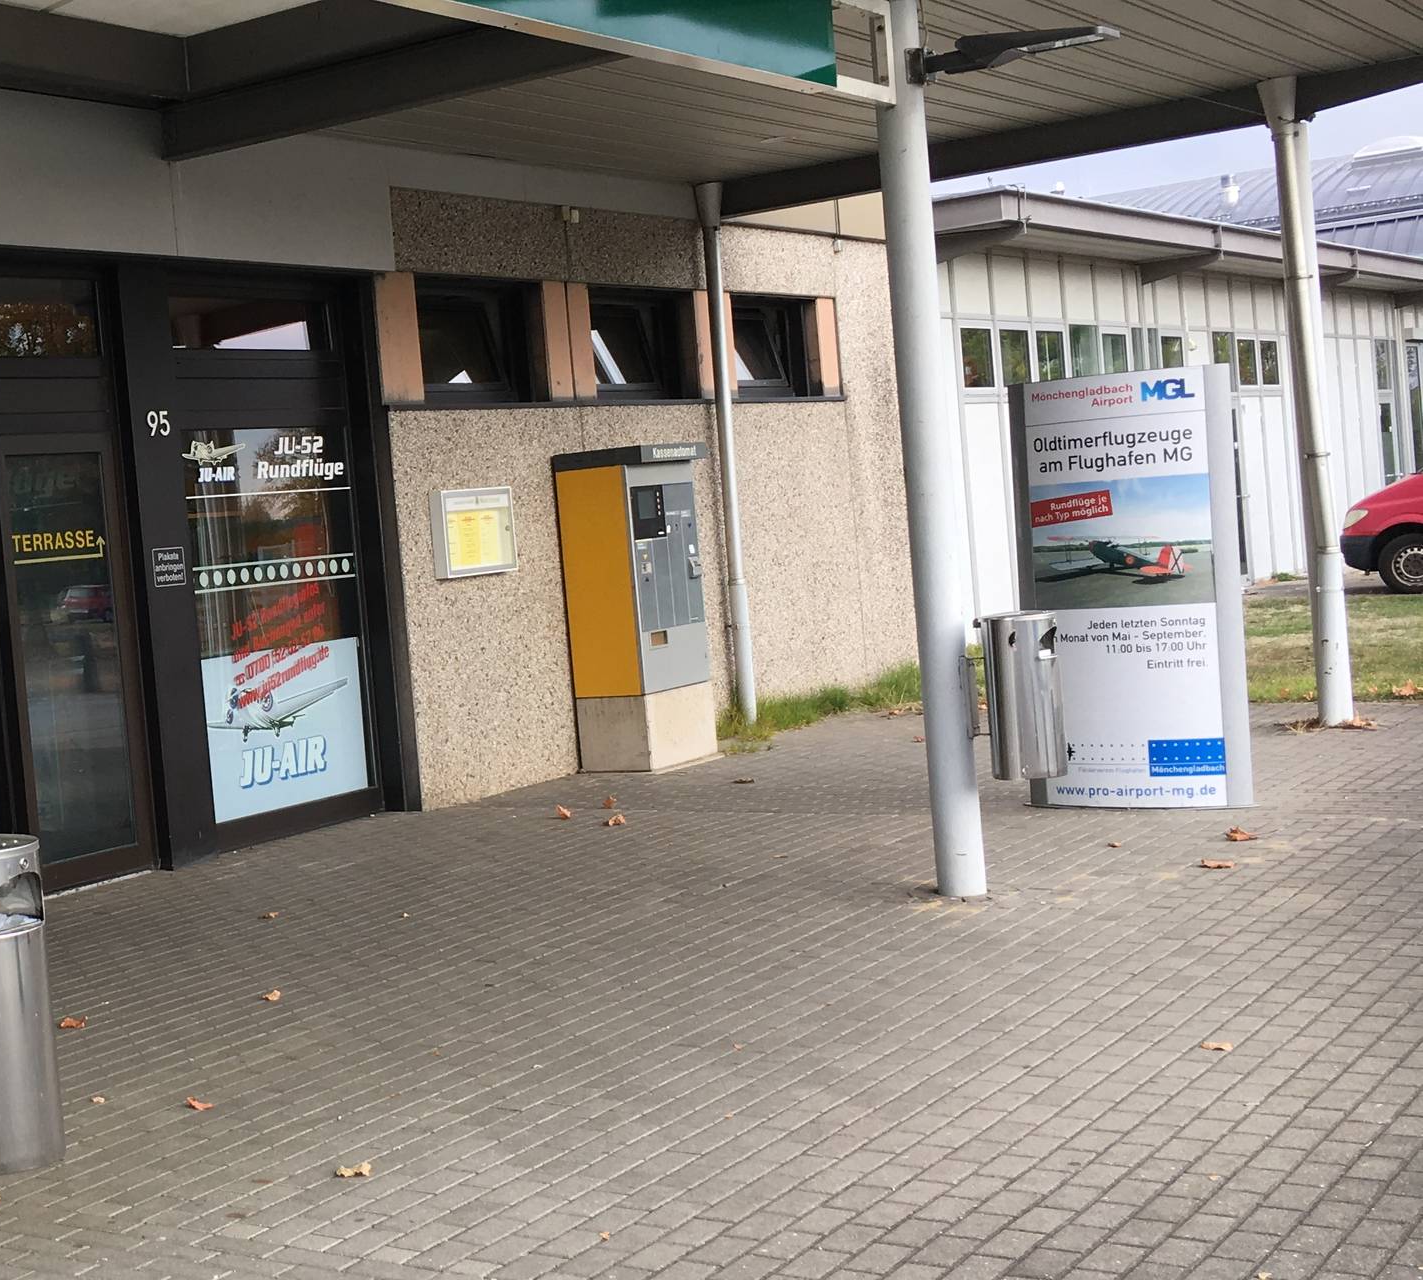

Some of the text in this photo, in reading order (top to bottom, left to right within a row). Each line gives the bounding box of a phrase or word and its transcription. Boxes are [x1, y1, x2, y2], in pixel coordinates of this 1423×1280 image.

[1031, 378, 1195, 403] Mönchengladbach MGL
[1091, 395, 1133, 408] Airport
[146, 410, 171, 437] 95
[274, 436, 324, 455] JU-52
[1033, 428, 1193, 453] Oldtimerflugzeuge
[652, 445, 697, 458] Kassenautomat
[1039, 446, 1193, 473] am Flughafen MG
[197, 466, 236, 483] JU-AIR
[257, 459, 345, 481] Rundflüge
[1050, 495, 1108, 511] Rundflüge je
[1034, 504, 1109, 523] nach Typ möglich
[11, 530, 95, 553] TERRASSE
[1087, 617, 1206, 630] Jeden letzten Sonntag
[1060, 633, 1089, 643] Monat
[1091, 634, 1109, 642] von
[1112, 632, 1131, 641] Mai
[1142, 629, 1207, 641] September.
[1135, 643, 1152, 653] bis
[1186, 641, 1207, 651] Uhr
[1146, 658, 1183, 669] Eintritt
[239, 736, 328, 789] JU-AIR
[1151, 763, 1225, 775] Mönchengladbach
[1056, 784, 1217, 799] www.pro-airport-mg.de
